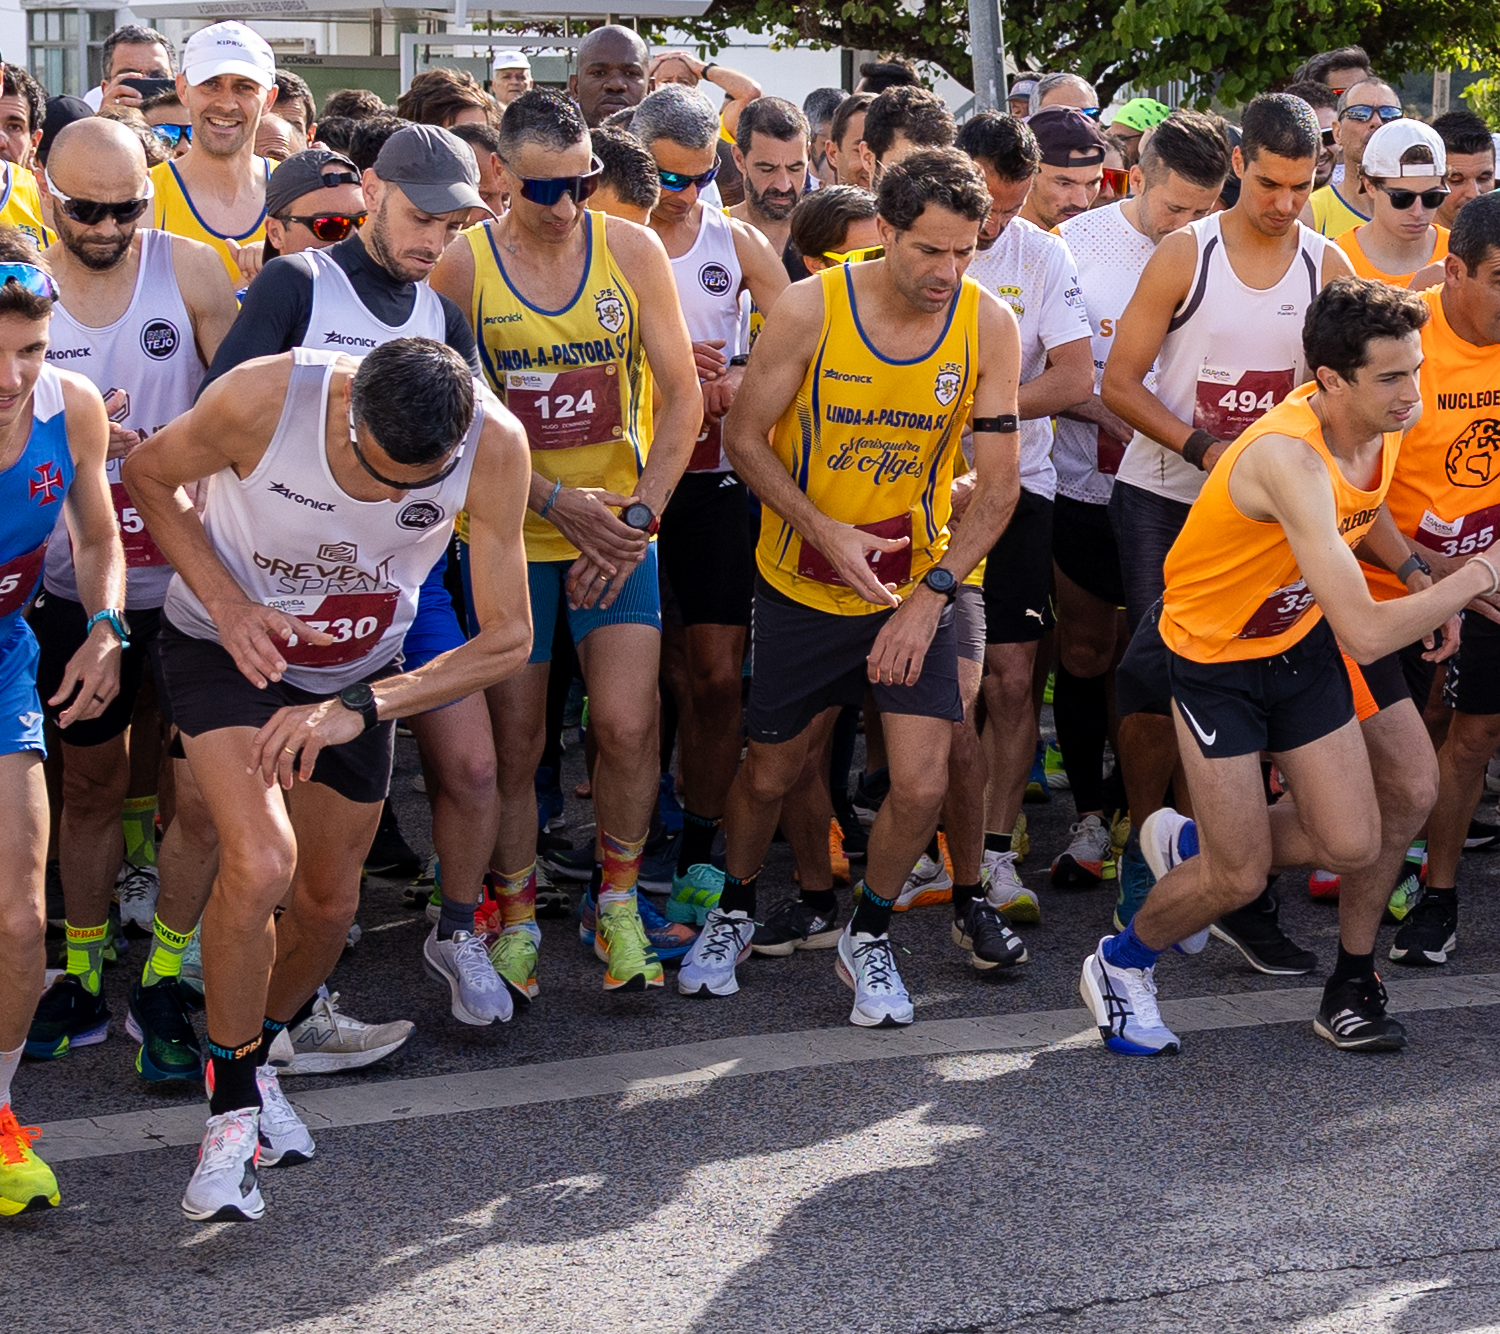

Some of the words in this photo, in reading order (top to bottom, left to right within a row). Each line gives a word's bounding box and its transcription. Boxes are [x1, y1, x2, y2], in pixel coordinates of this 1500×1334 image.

[216, 40, 244, 48] KIPRU
[280, 55, 323, 65] JCDecaux
[704, 277, 728, 287] TEJO
[146, 338, 174, 350] TEJO
[534, 389, 596, 420] 124
[1218, 389, 1275, 413] 494
[826, 404, 932, 431] LINDA-A-PASTORA
[840, 436, 921, 455] Marisqueira
[827, 451, 855, 471] de
[857, 451, 924, 485] Algés
[267, 480, 337, 512] Aronick
[1441, 525, 1494, 558] 355
[253, 551, 395, 583] PREVENT
[1277, 592, 1315, 614] 35
